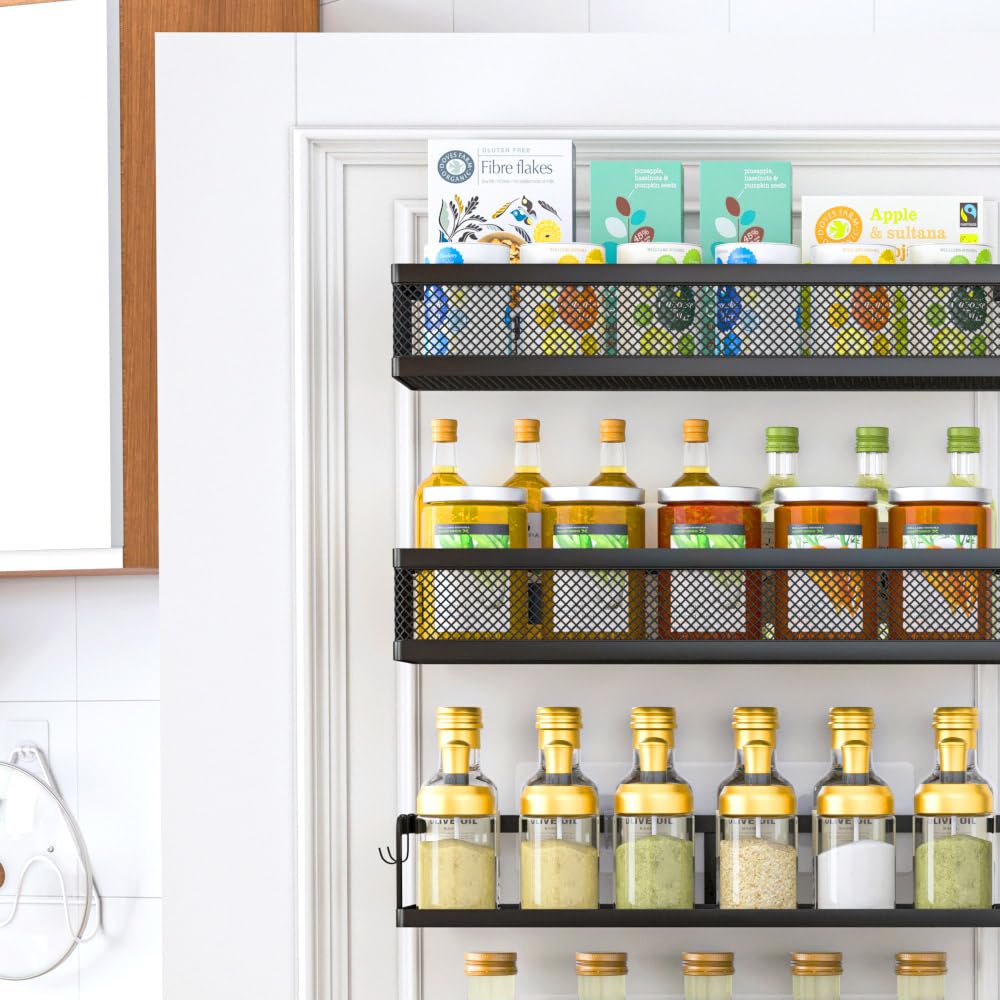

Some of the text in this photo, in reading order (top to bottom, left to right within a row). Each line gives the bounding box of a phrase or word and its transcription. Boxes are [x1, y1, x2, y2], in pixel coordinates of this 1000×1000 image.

[440, 151, 458, 169] DOVES
[481, 160, 553, 174] Fibre flakes
[440, 169, 472, 183] ORGANIC
[869, 207, 918, 224] Apple
[870, 226, 882, 239] &
[886, 226, 947, 239] sultana
